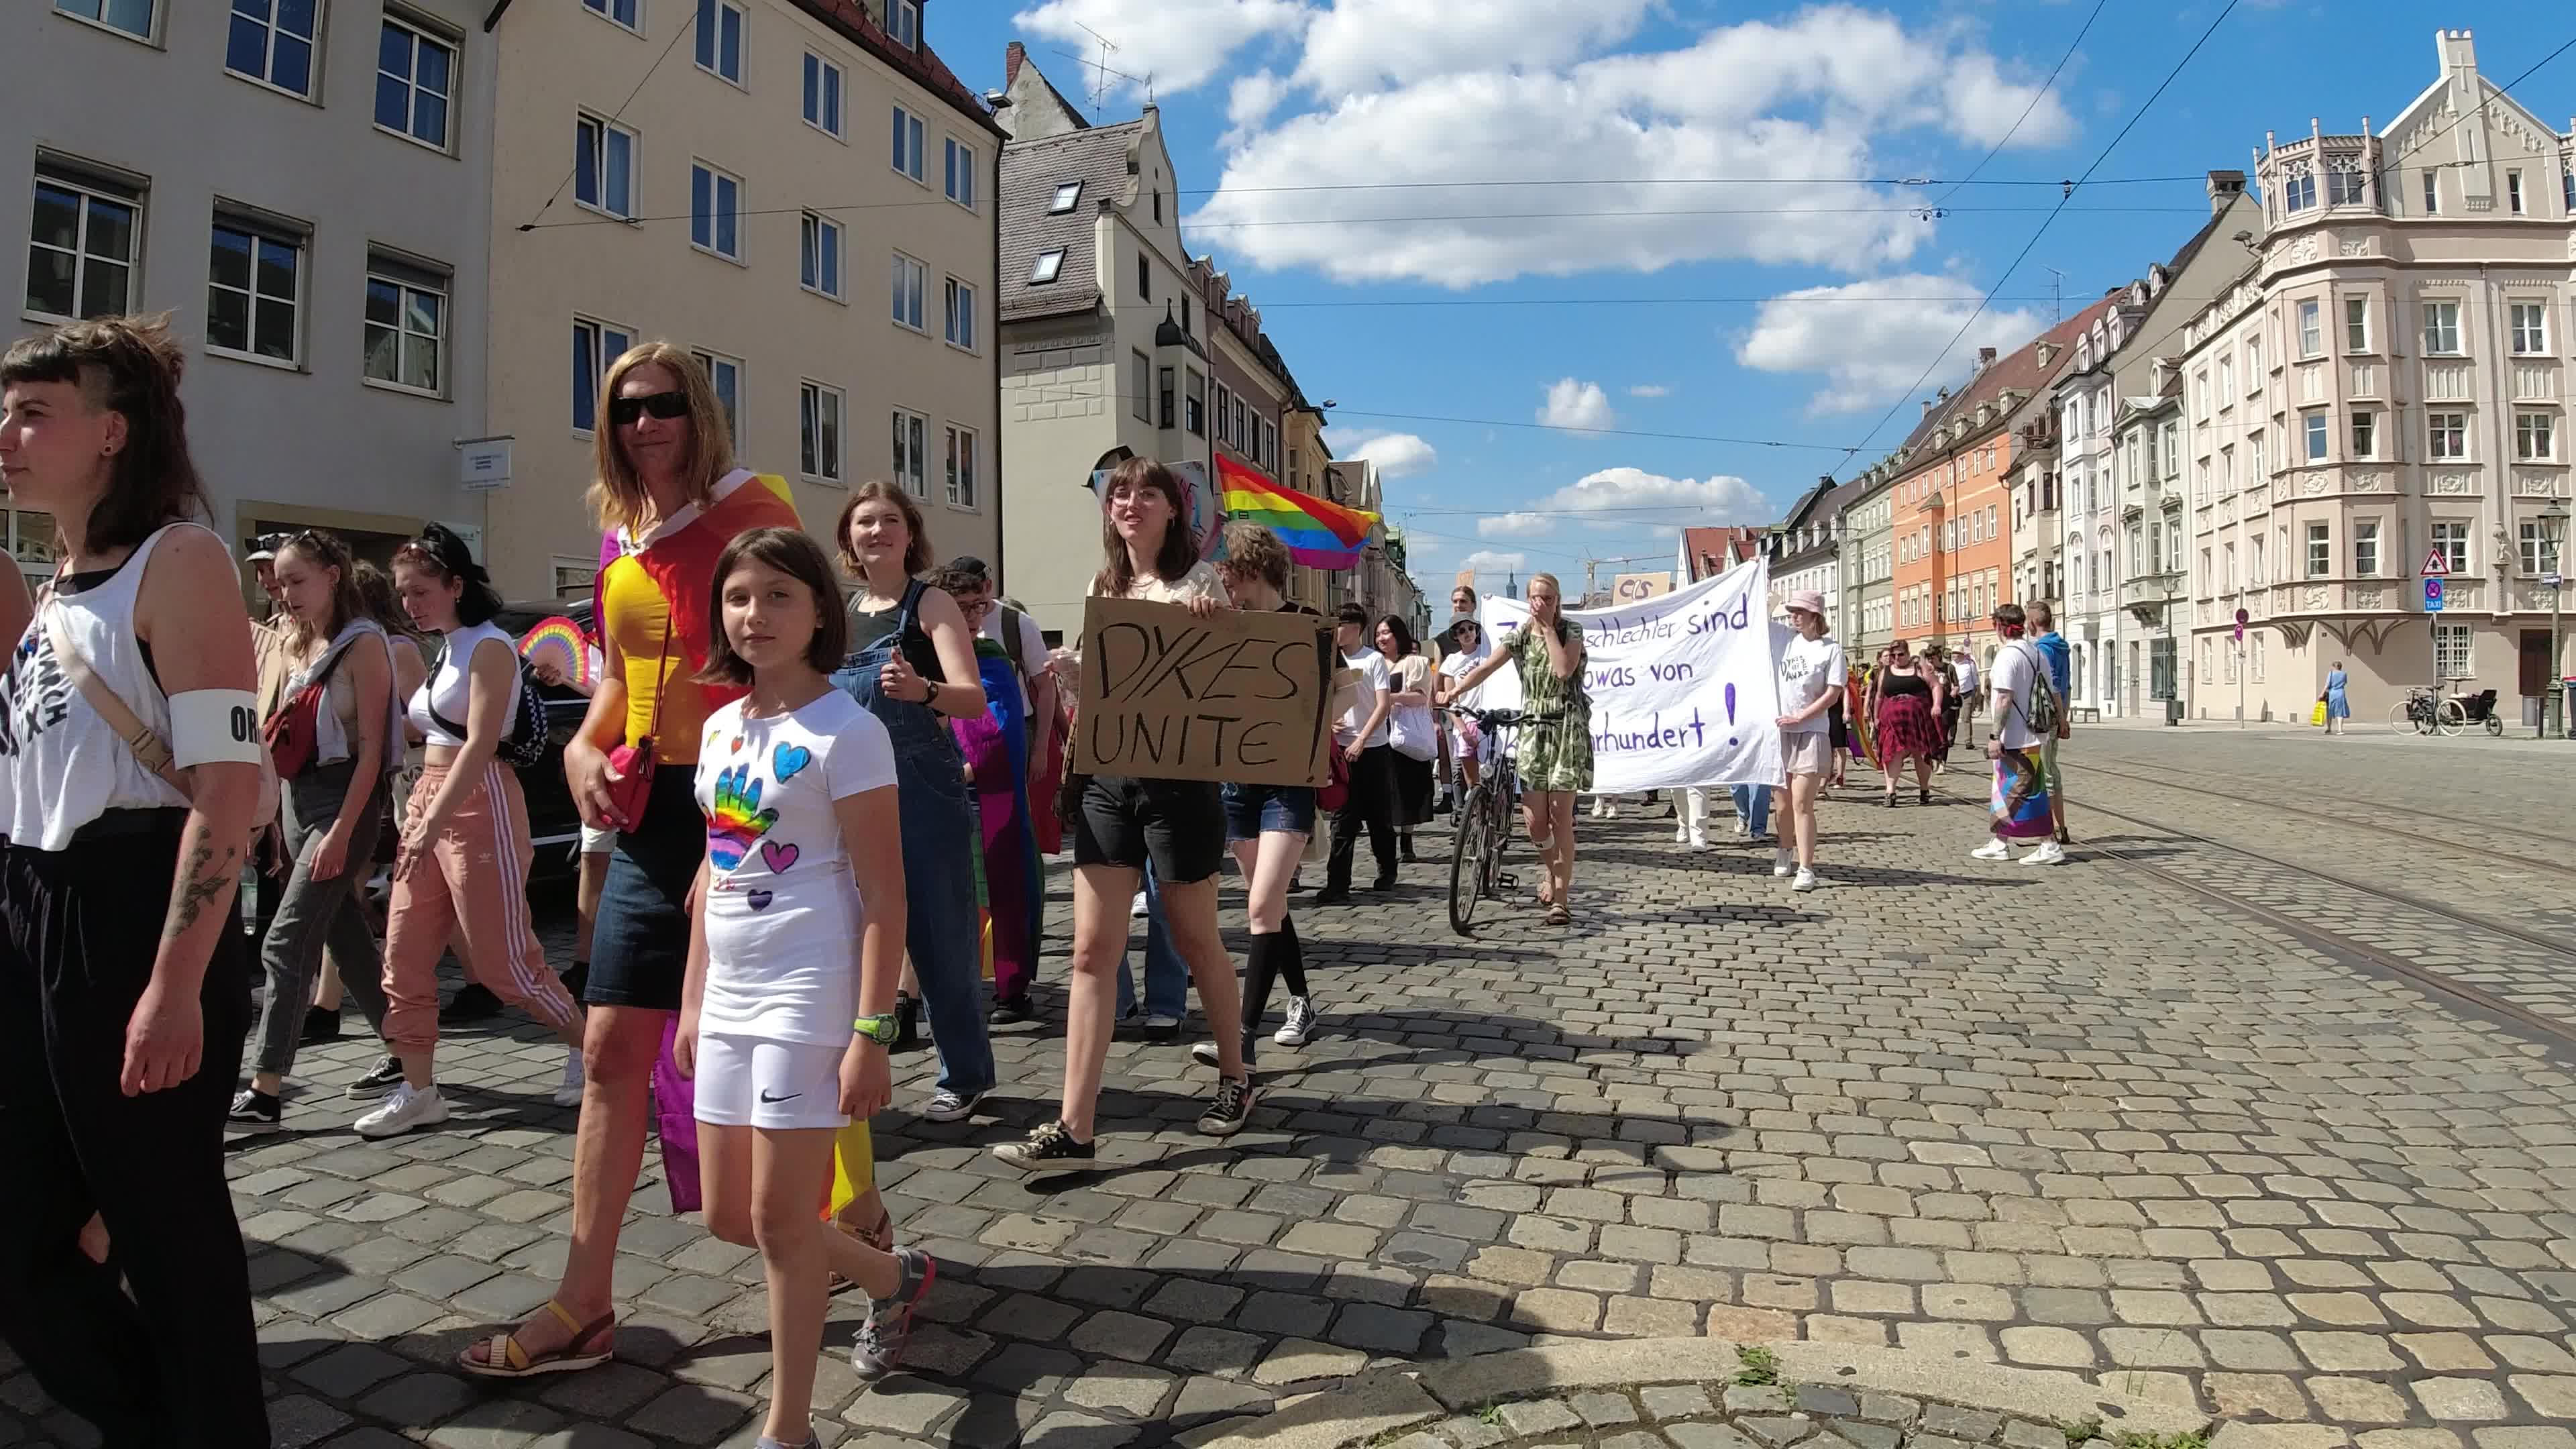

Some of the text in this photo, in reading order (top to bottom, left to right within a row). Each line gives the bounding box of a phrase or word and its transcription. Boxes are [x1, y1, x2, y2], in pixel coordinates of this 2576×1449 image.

[1686, 592, 1749, 635] sind
[2426, 600, 2442, 609] TAXI
[1097, 623, 1312, 703] DYKES
[1650, 662, 1693, 682] von
[1092, 711, 1284, 767] UNITE
